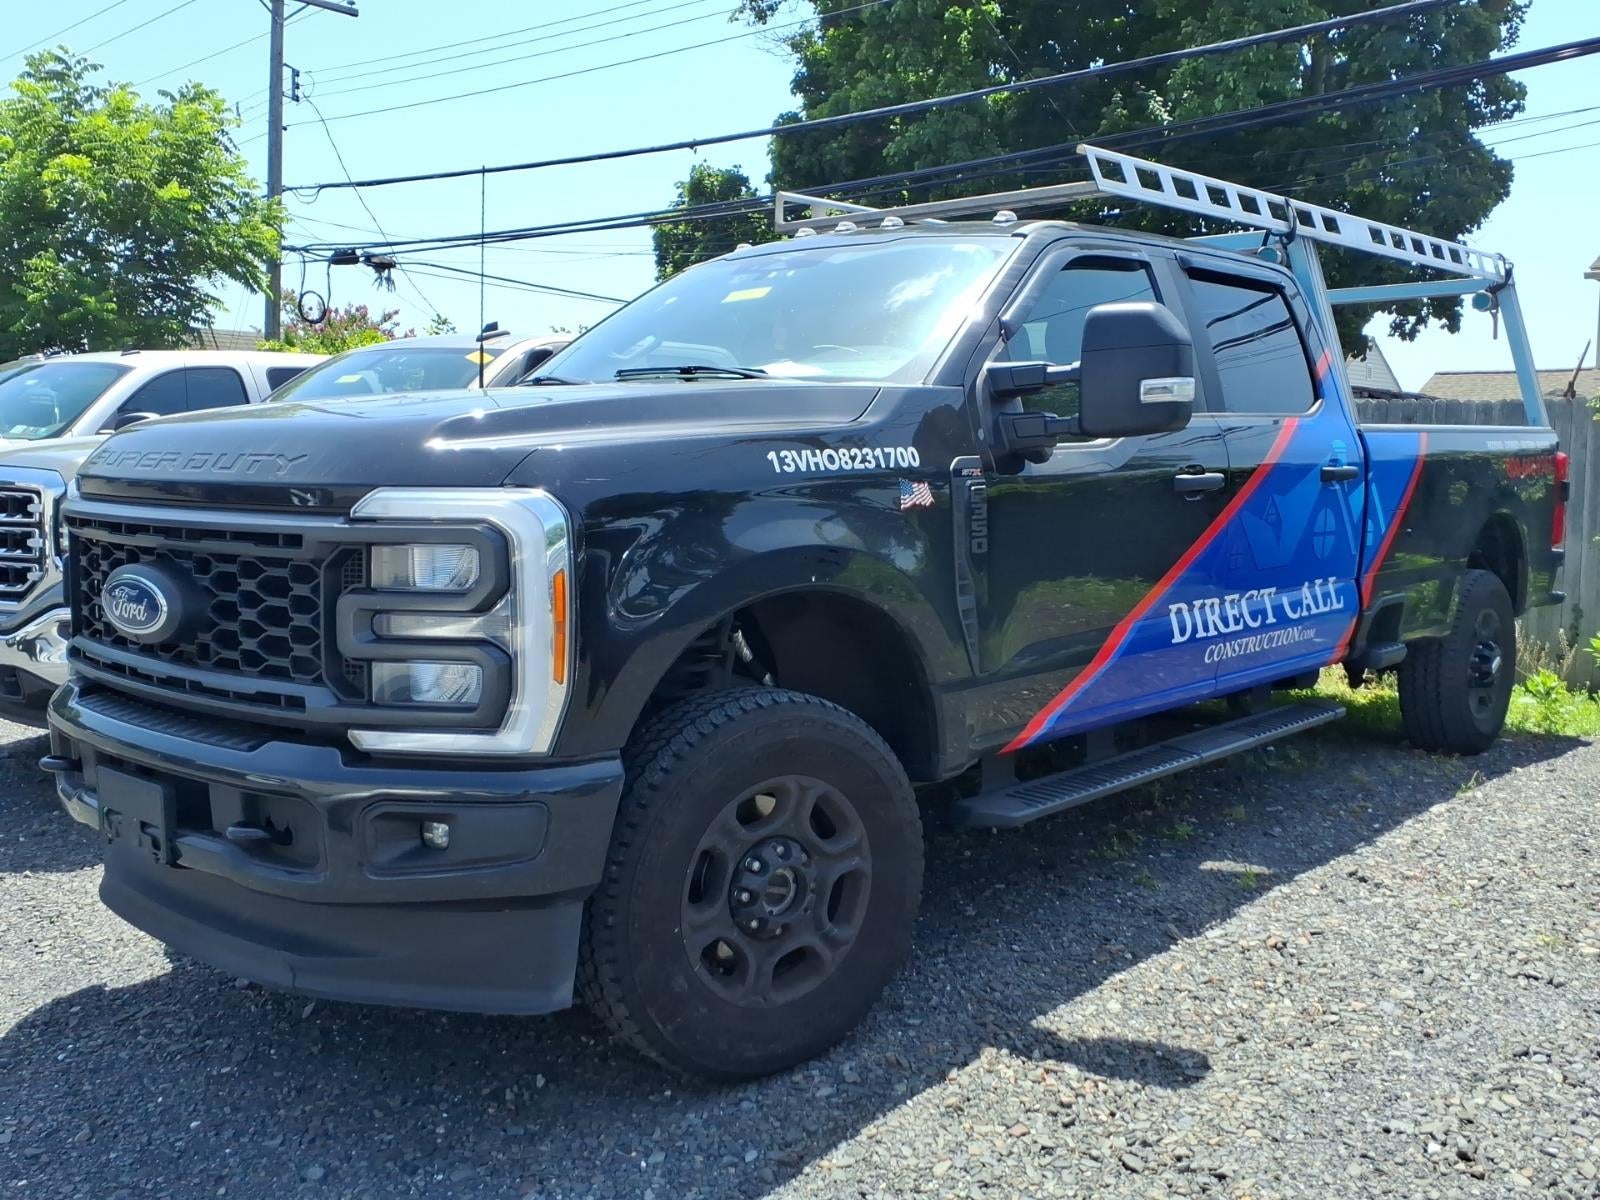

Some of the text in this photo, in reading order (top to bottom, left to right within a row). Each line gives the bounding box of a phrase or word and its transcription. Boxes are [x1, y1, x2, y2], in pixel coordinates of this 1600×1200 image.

[181, 453, 308, 475] DUTY
[111, 586, 148, 621] Ford
[1168, 576, 1344, 644] DIRECT CALL
